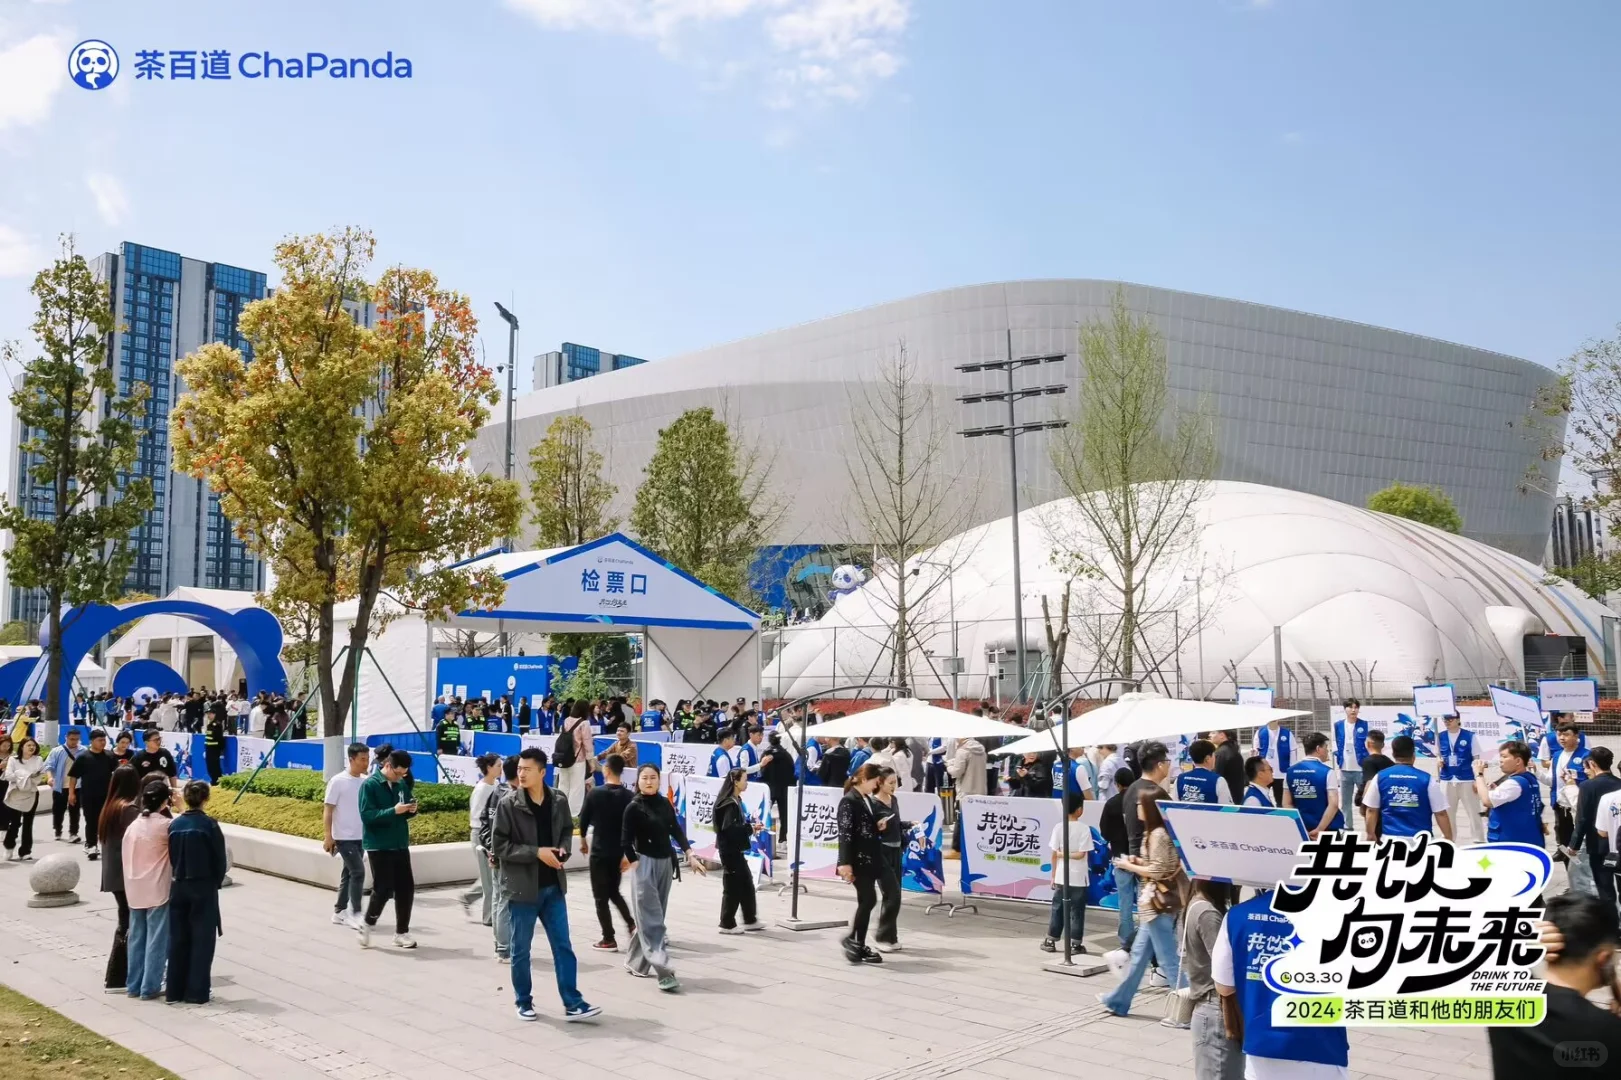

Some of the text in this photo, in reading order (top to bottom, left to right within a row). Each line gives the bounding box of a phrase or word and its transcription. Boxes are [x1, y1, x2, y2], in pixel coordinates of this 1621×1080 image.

[581, 569, 648, 595] 检票口
[977, 811, 1027, 831] 共饮
[988, 830, 1041, 855] 向未来
[1210, 840, 1294, 856] 茶百道 ChaPanda
